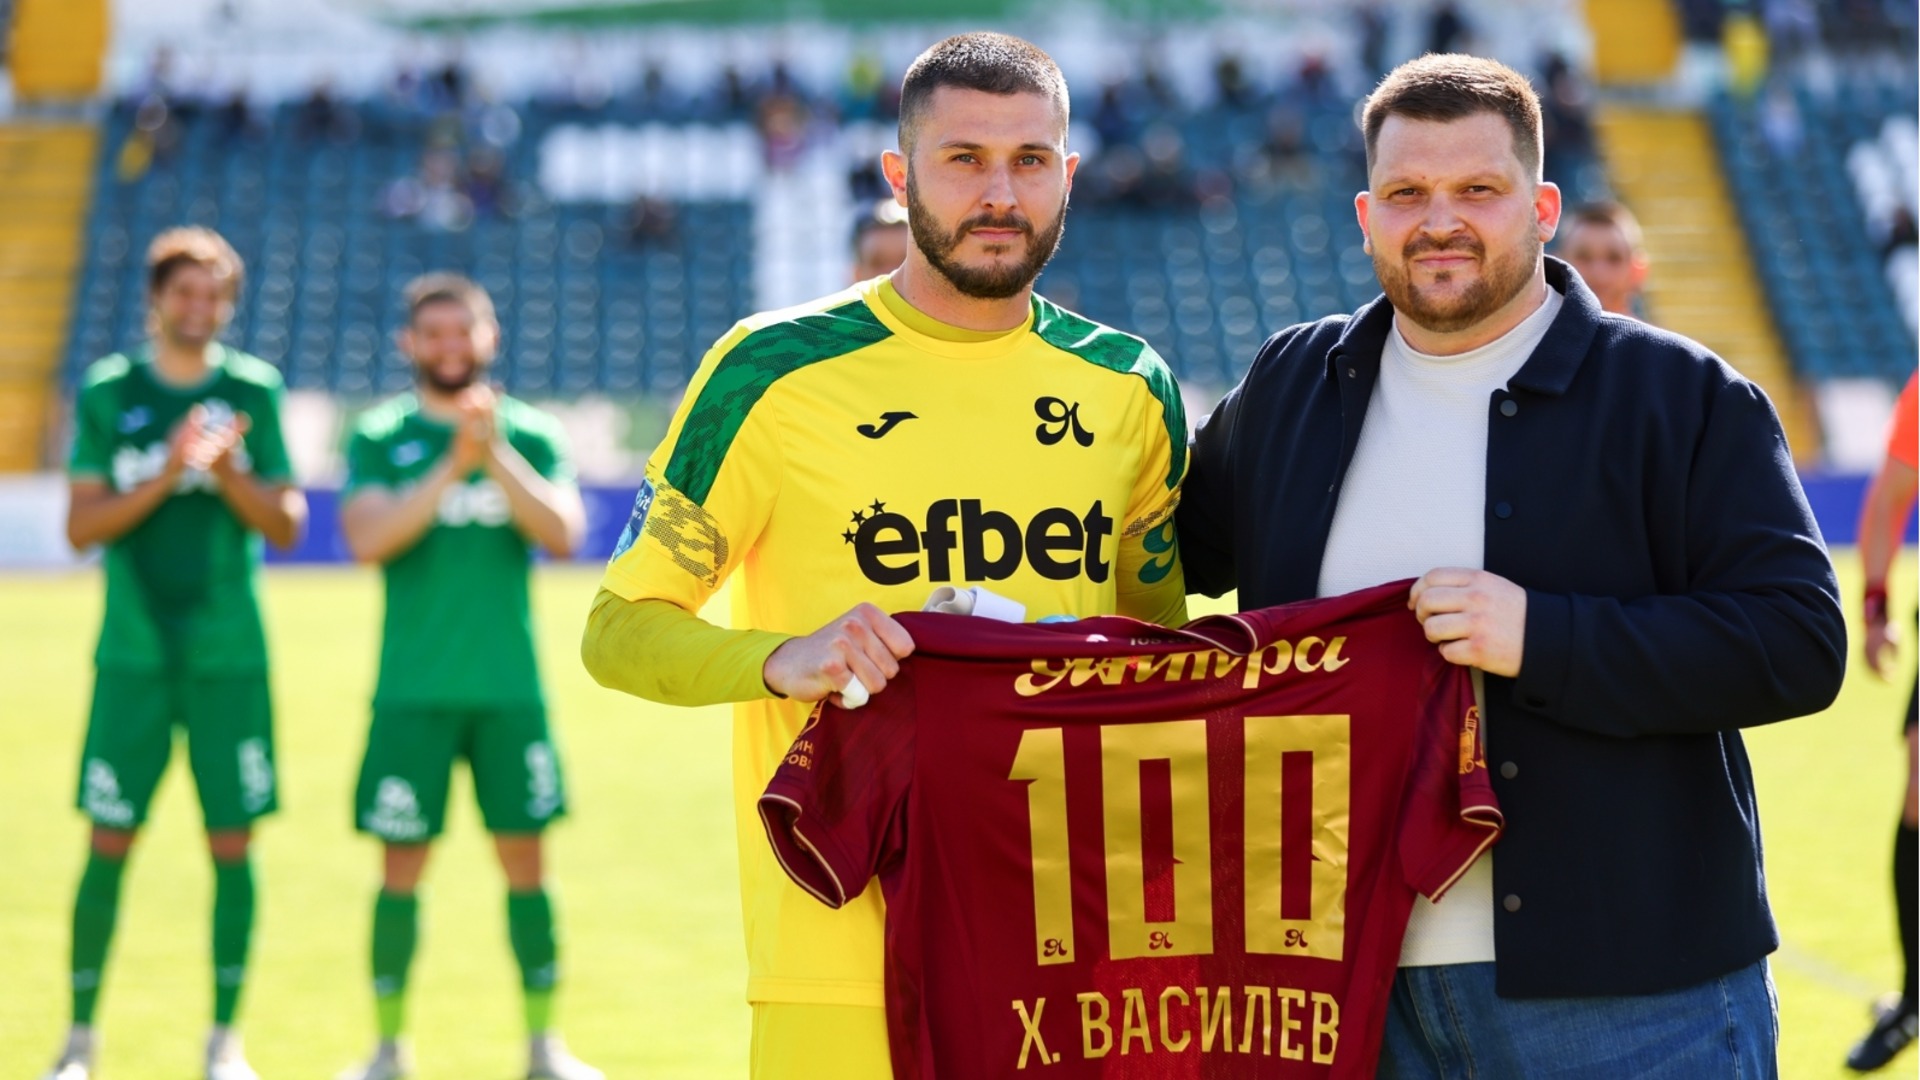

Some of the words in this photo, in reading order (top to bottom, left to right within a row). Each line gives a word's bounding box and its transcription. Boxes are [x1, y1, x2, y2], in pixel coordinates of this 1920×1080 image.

[854, 498, 1113, 586] efbet
[1008, 714, 1350, 966] 100
[1012, 997, 1061, 1070] Х.
[1076, 985, 1340, 1065] ВАСИЛЕВ
